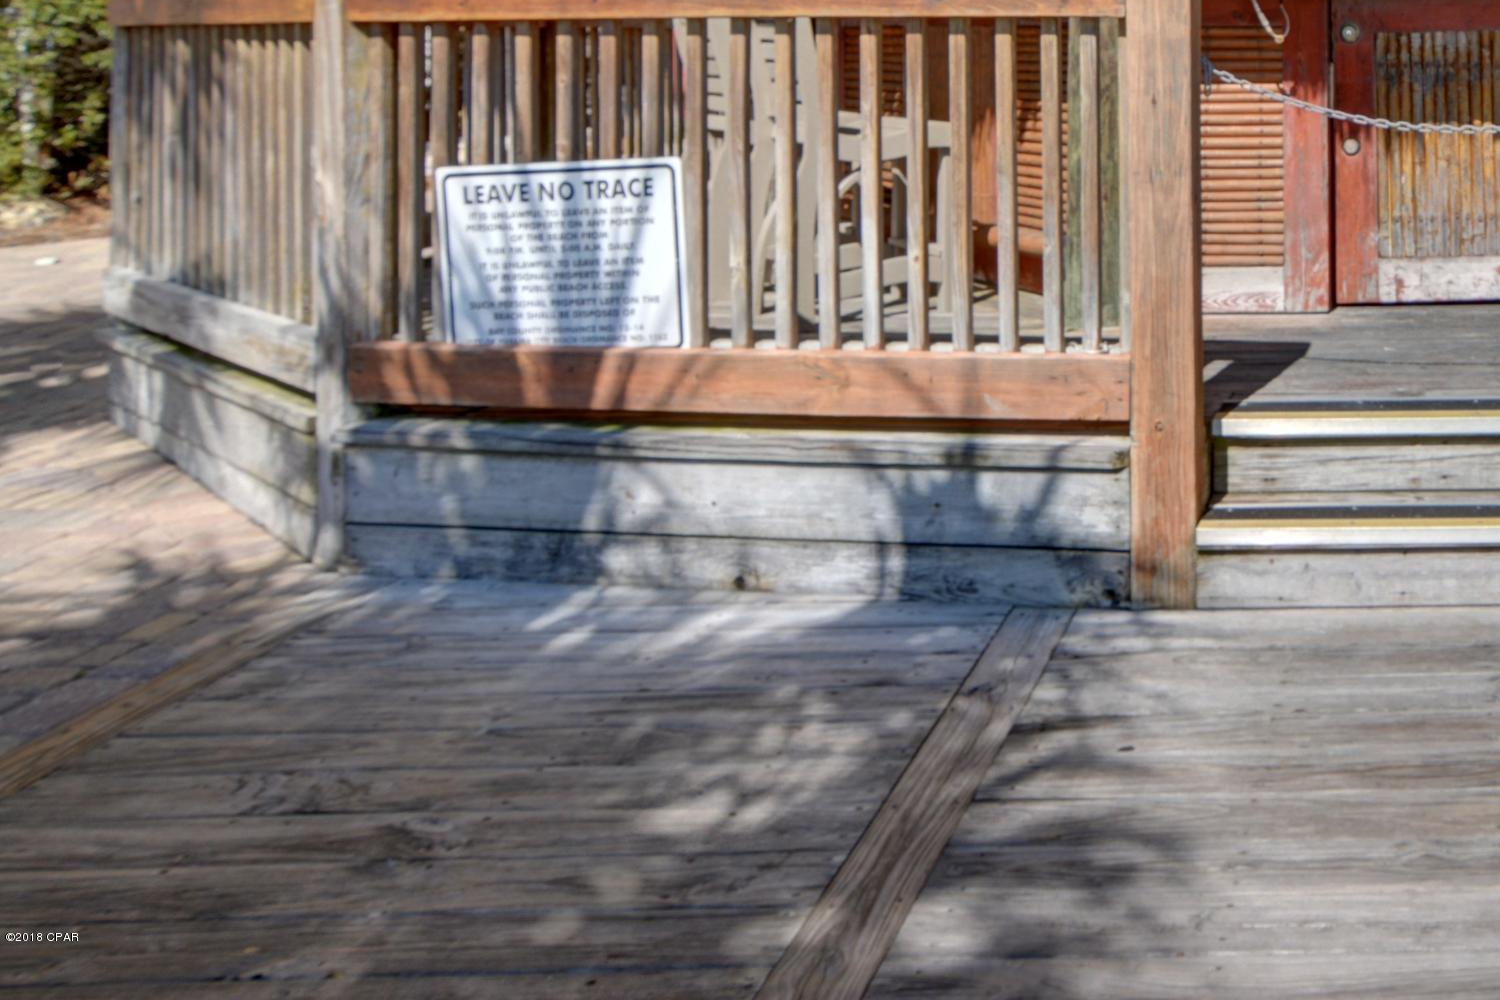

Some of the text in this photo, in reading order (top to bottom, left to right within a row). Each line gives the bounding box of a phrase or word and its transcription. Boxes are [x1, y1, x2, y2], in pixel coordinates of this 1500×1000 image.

[463, 177, 654, 205] LEAVE NO TRACE
